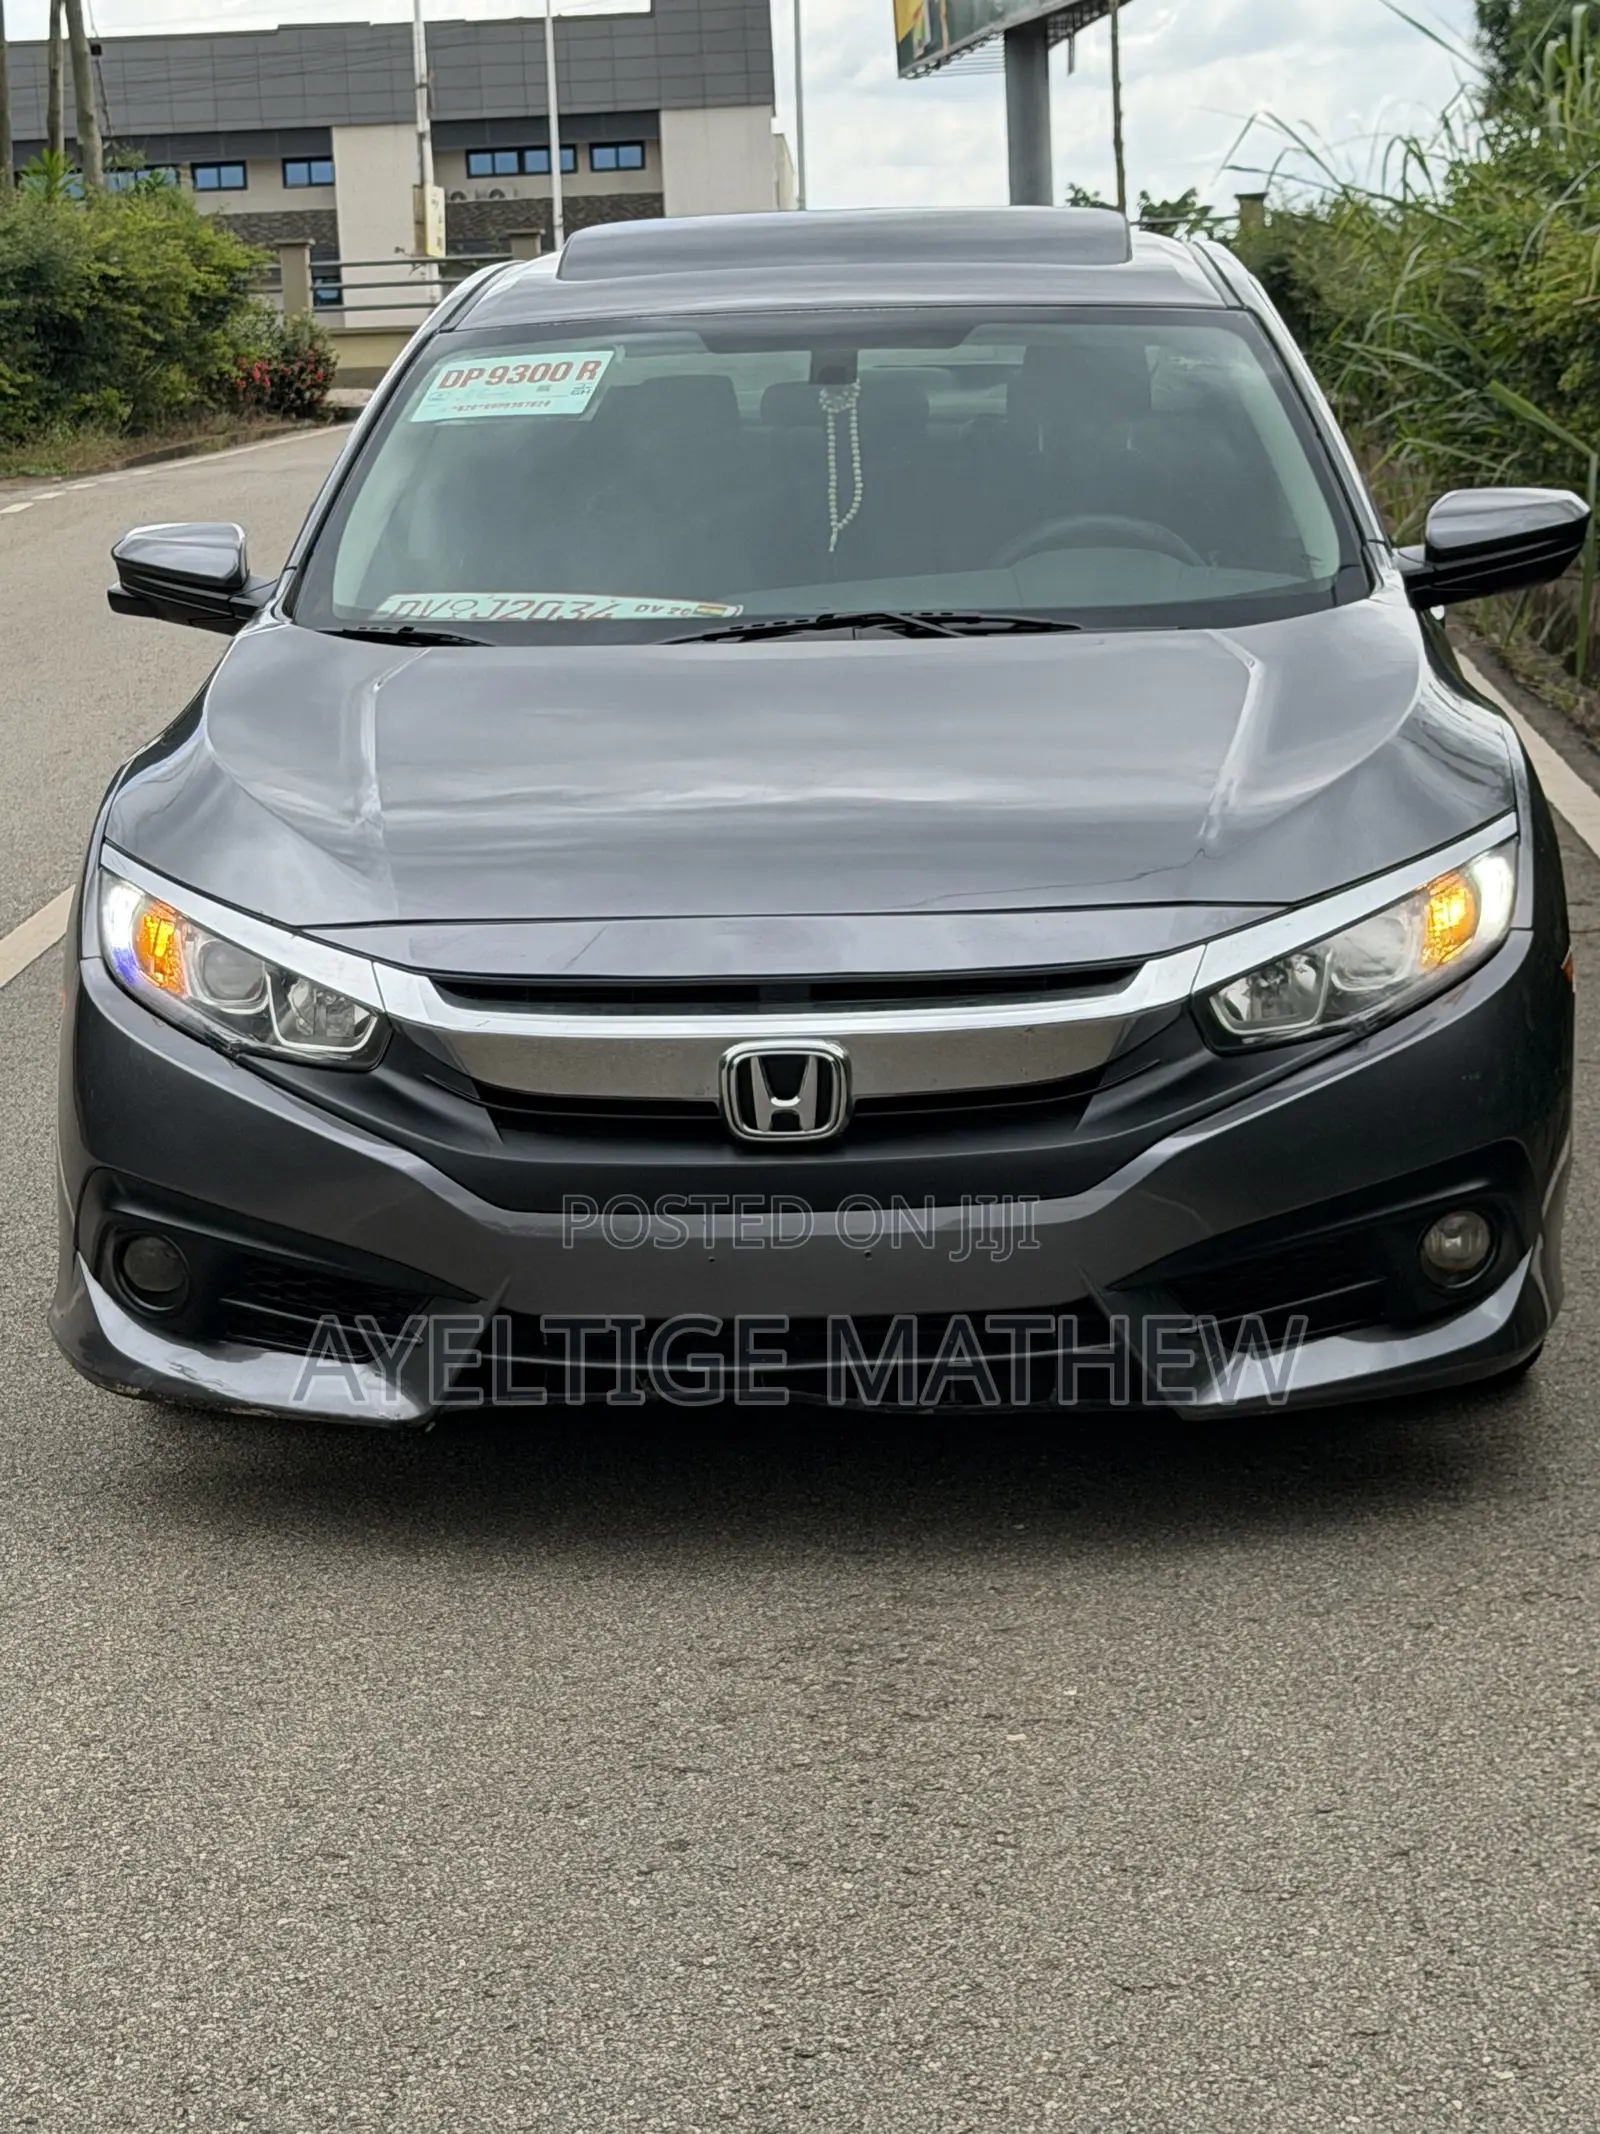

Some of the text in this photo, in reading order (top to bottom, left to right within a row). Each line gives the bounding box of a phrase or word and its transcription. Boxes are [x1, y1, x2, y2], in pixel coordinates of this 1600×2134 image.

[438, 360, 602, 390] DP 9300 R
